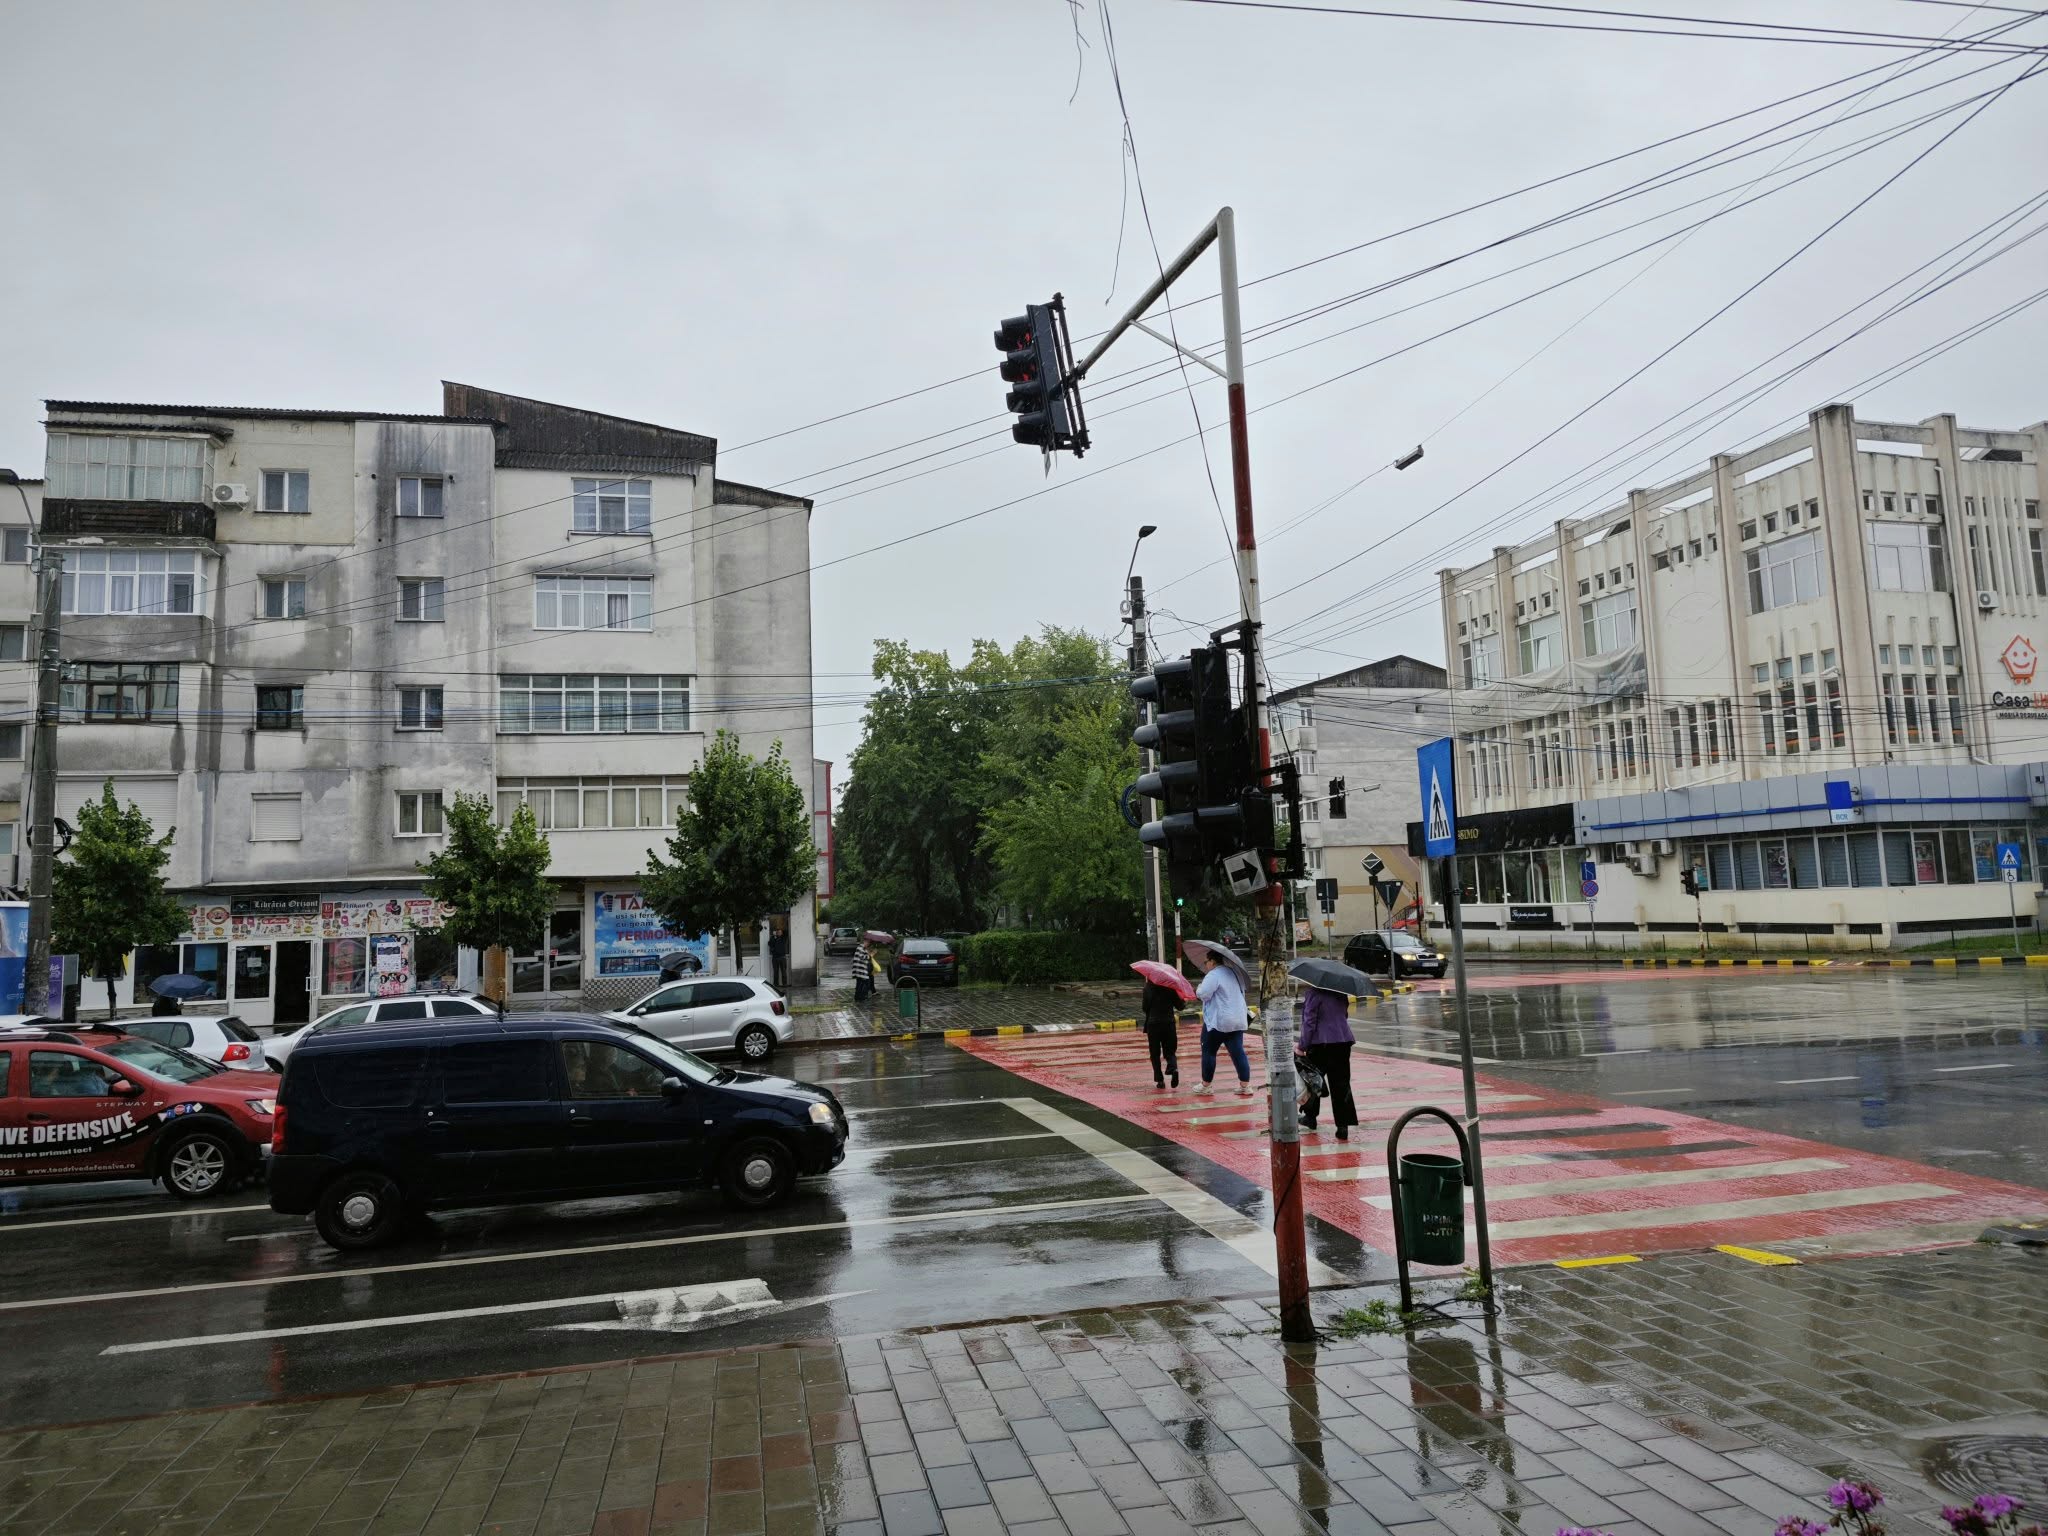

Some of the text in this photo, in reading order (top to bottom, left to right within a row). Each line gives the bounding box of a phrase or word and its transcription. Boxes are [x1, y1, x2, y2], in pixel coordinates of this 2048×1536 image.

[1993, 691, 2030, 707] Casa
[1835, 813, 1849, 821] BCR
[288, 899, 318, 908] Orizont
[629, 920, 654, 929] geam
[34, 1111, 136, 1144] DEFENSIVE
[39, 1148, 72, 1157] primul
[73, 1146, 92, 1154] loc!
